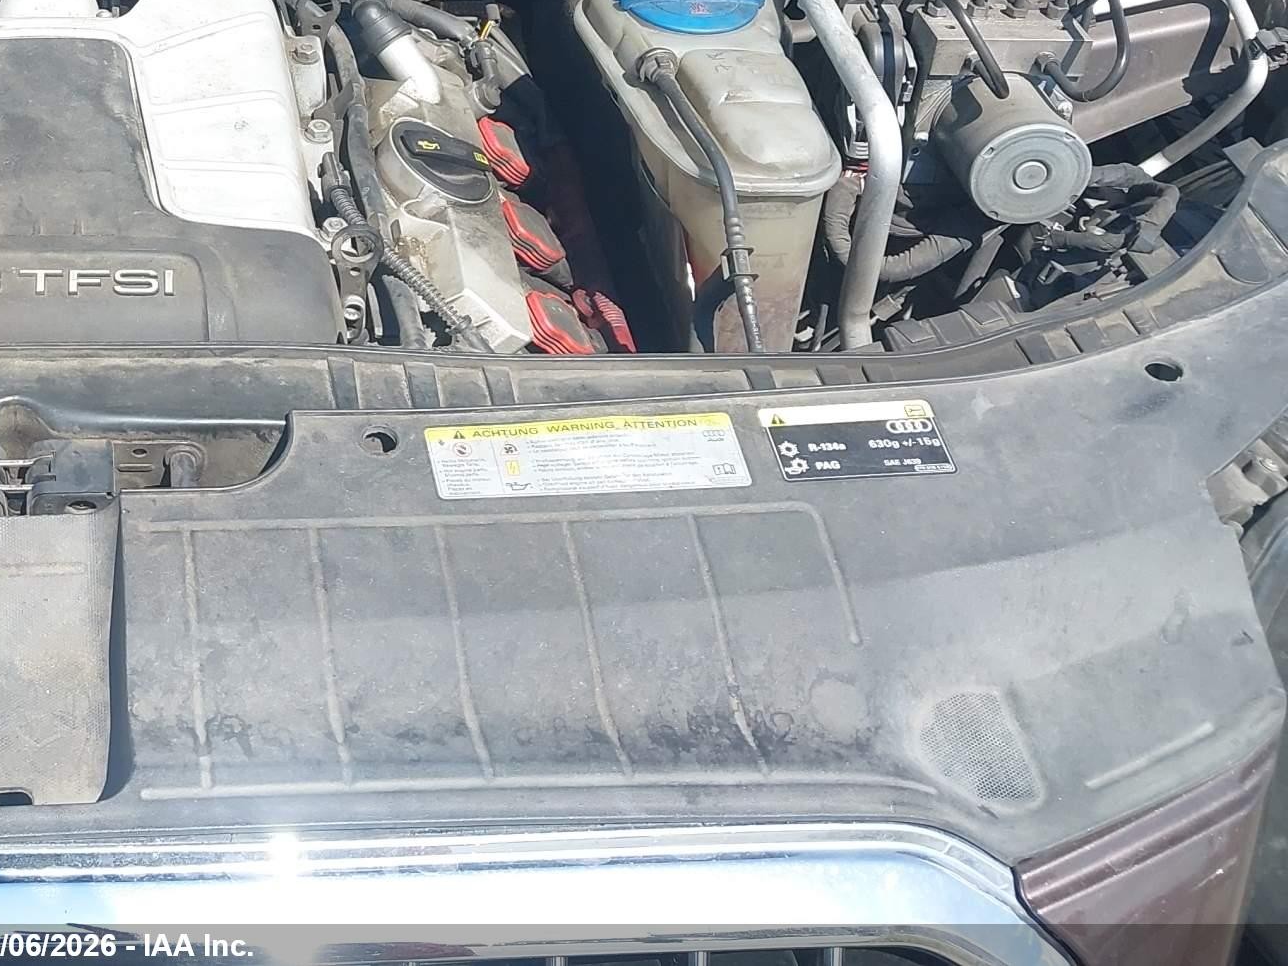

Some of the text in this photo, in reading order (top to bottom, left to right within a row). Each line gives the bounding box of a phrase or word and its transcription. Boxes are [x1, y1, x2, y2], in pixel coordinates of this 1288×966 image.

[18, 268, 176, 297] TFSI
[472, 419, 697, 438] ACHTUNG WARNING ATTENTION
[807, 442, 847, 452] R-134a
[868, 439, 900, 450] 630g
[815, 460, 841, 470] PAG
